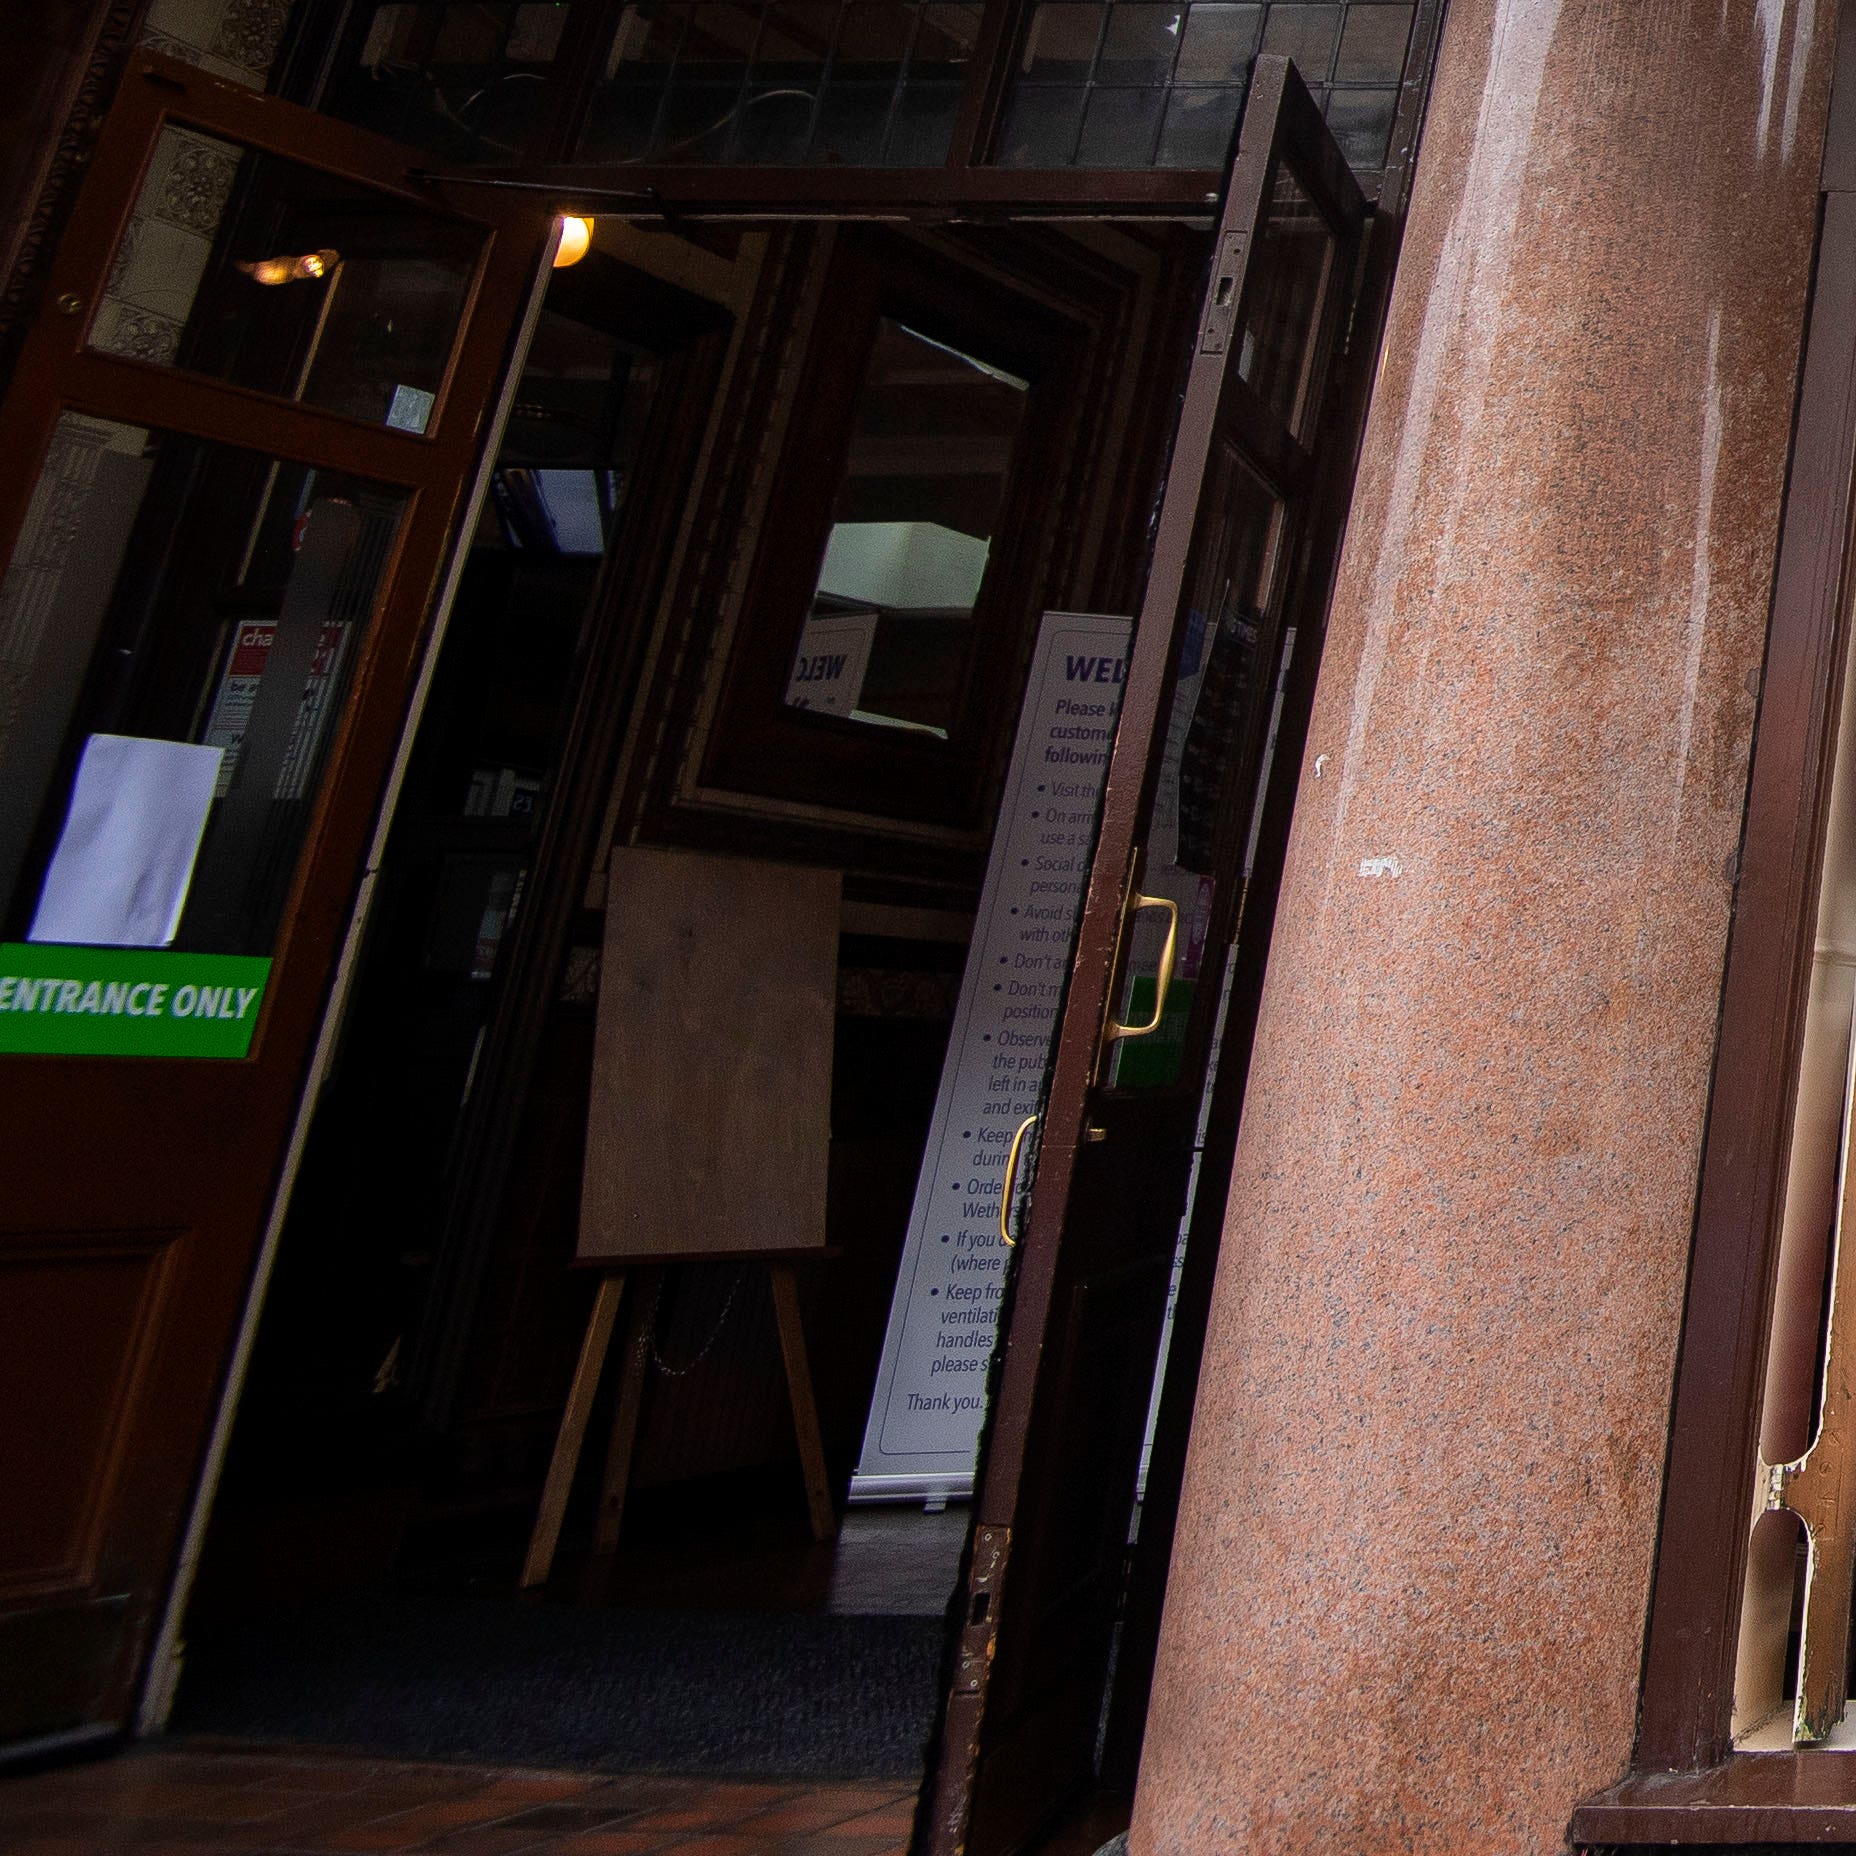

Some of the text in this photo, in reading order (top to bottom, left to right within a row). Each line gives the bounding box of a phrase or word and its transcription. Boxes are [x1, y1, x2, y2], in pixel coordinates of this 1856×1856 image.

[1066, 655, 1124, 684] WEL
[1055, 699, 1106, 717] Please
[1035, 855, 1075, 872] Social
[1023, 905, 1064, 920] Avoid
[1020, 926, 1049, 942] with
[0, 975, 258, 1019] ENTRANCE ONLY
[992, 1052, 1016, 1070] the
[988, 1074, 1010, 1092] left
[1013, 1076, 1027, 1092] in
[983, 1097, 1012, 1115] and
[957, 1229, 996, 1252] If you
[951, 1253, 1001, 1274] (where
[946, 1282, 983, 1305] Keep
[936, 1330, 993, 1348] handles
[930, 1354, 978, 1377] please
[907, 1392, 984, 1415] Thank you.
